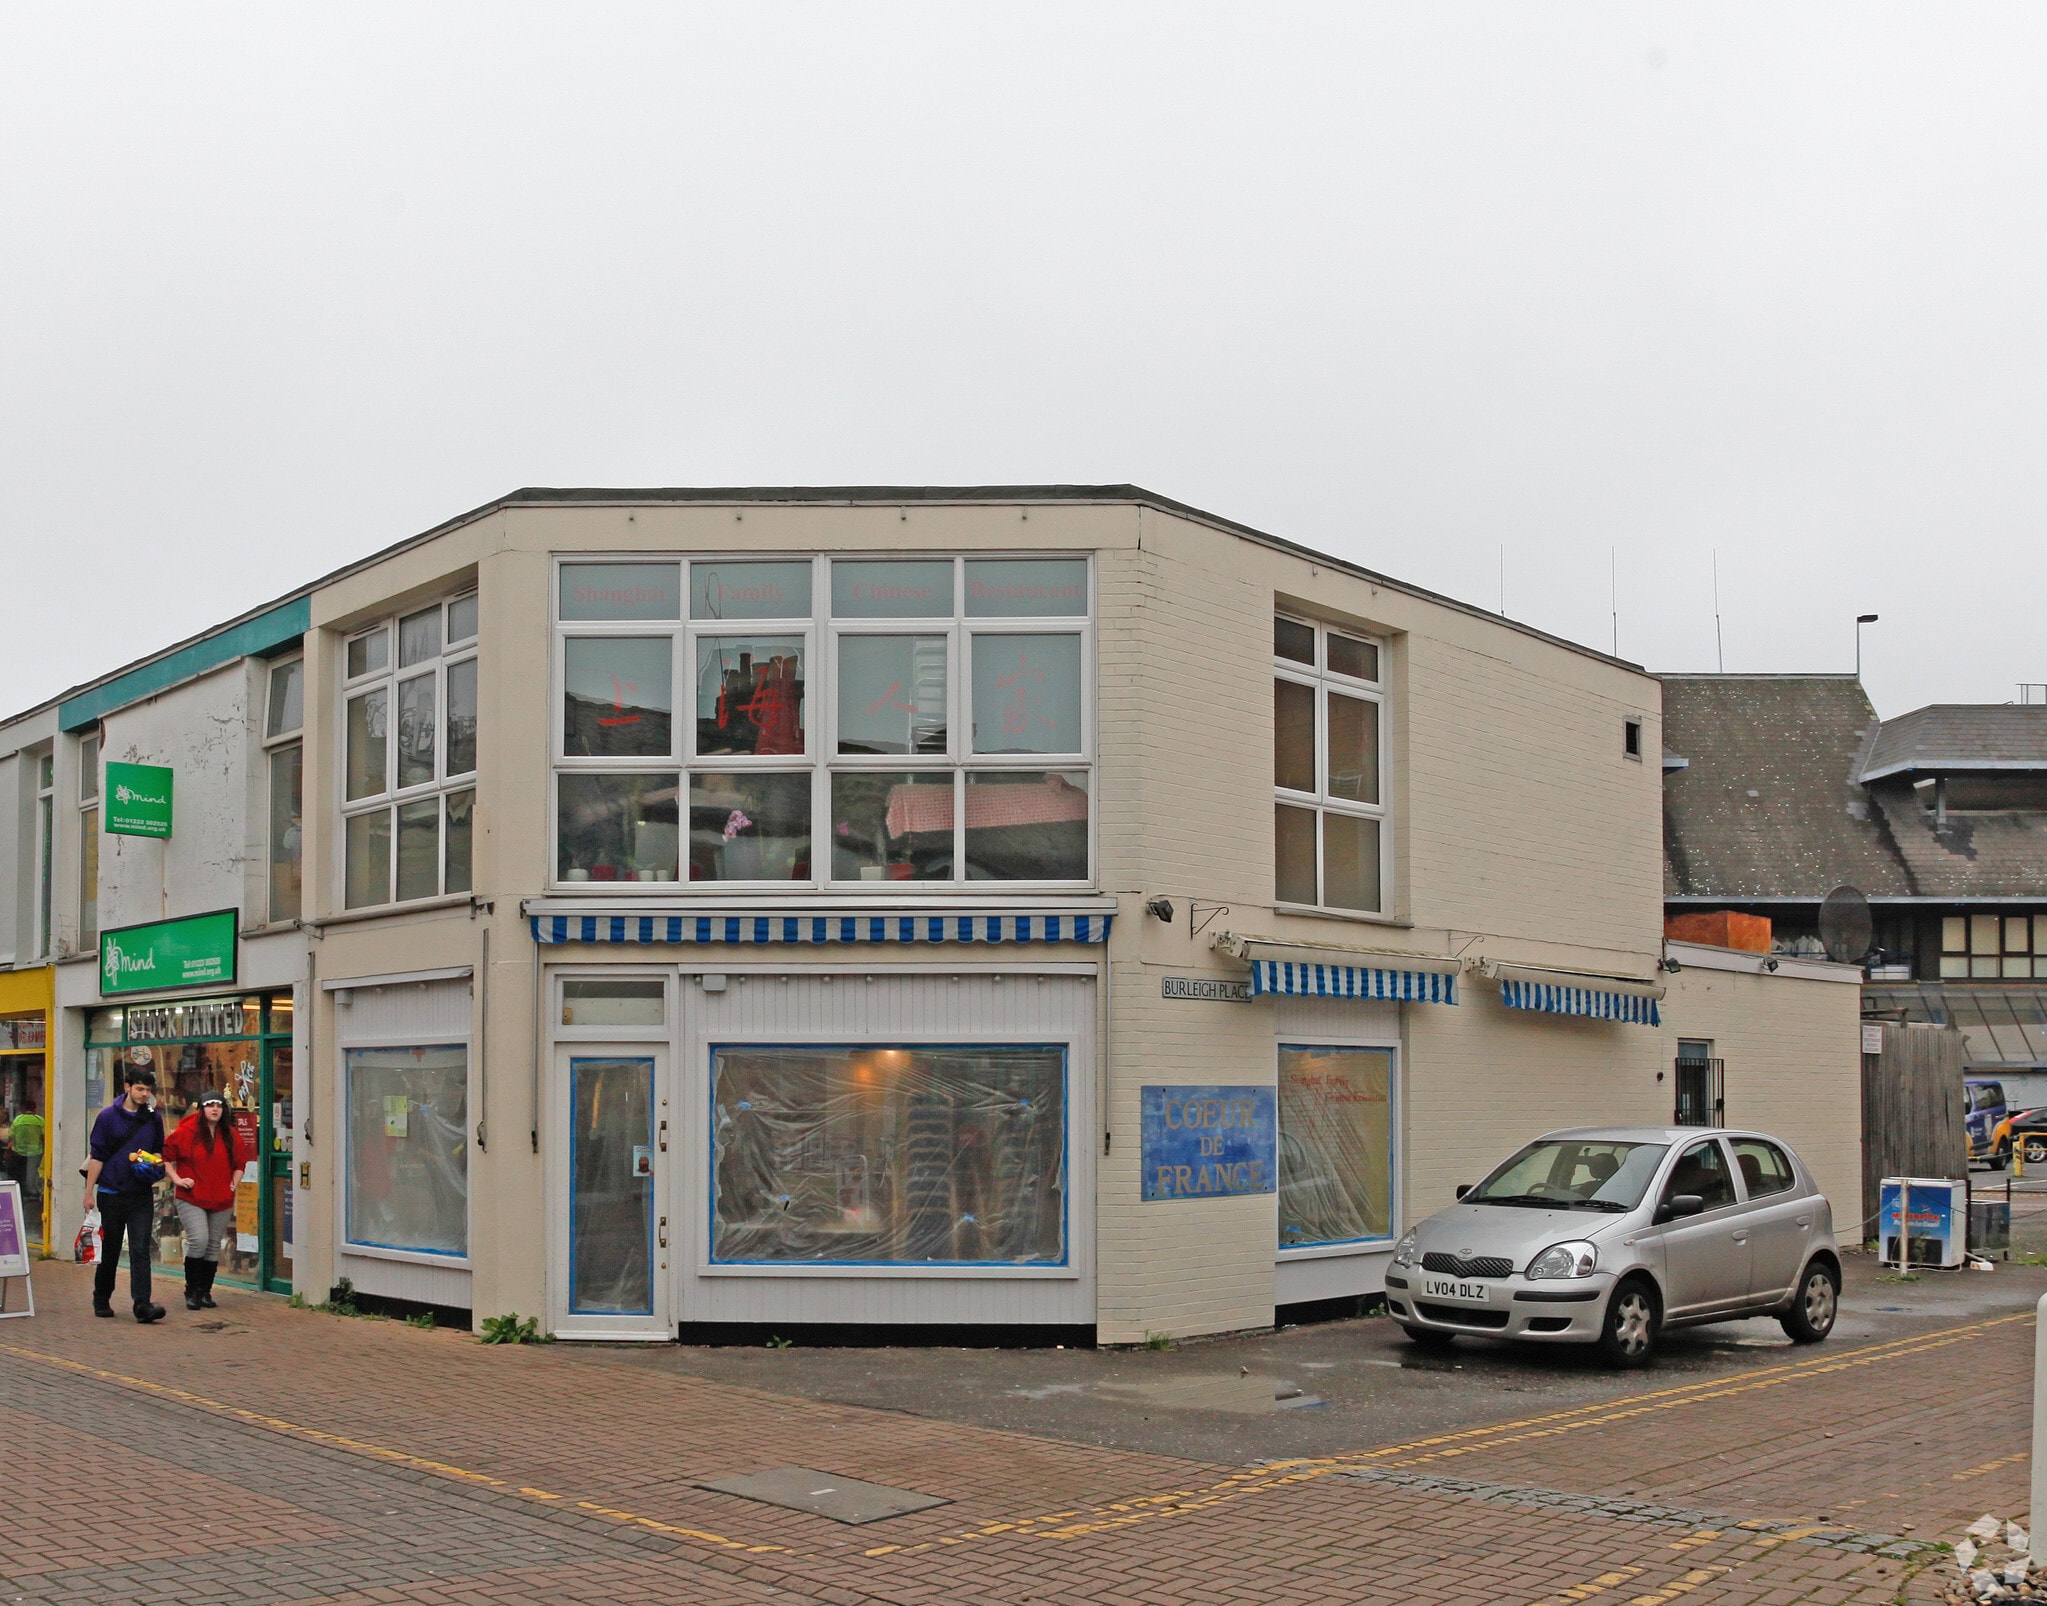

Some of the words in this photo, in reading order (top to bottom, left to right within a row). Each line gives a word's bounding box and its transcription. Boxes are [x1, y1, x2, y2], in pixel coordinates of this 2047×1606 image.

[1164, 980, 1217, 998] BURLEIGH
[130, 1006, 177, 1040] STOCK
[182, 1002, 244, 1038] WANTED
[1165, 1099, 1257, 1130] COEUR
[1200, 1136, 1225, 1157] DE
[1156, 1161, 1265, 1195] FRANCE
[1426, 1281, 1456, 1296] LV04
[1460, 1284, 1484, 1298] DLZ
